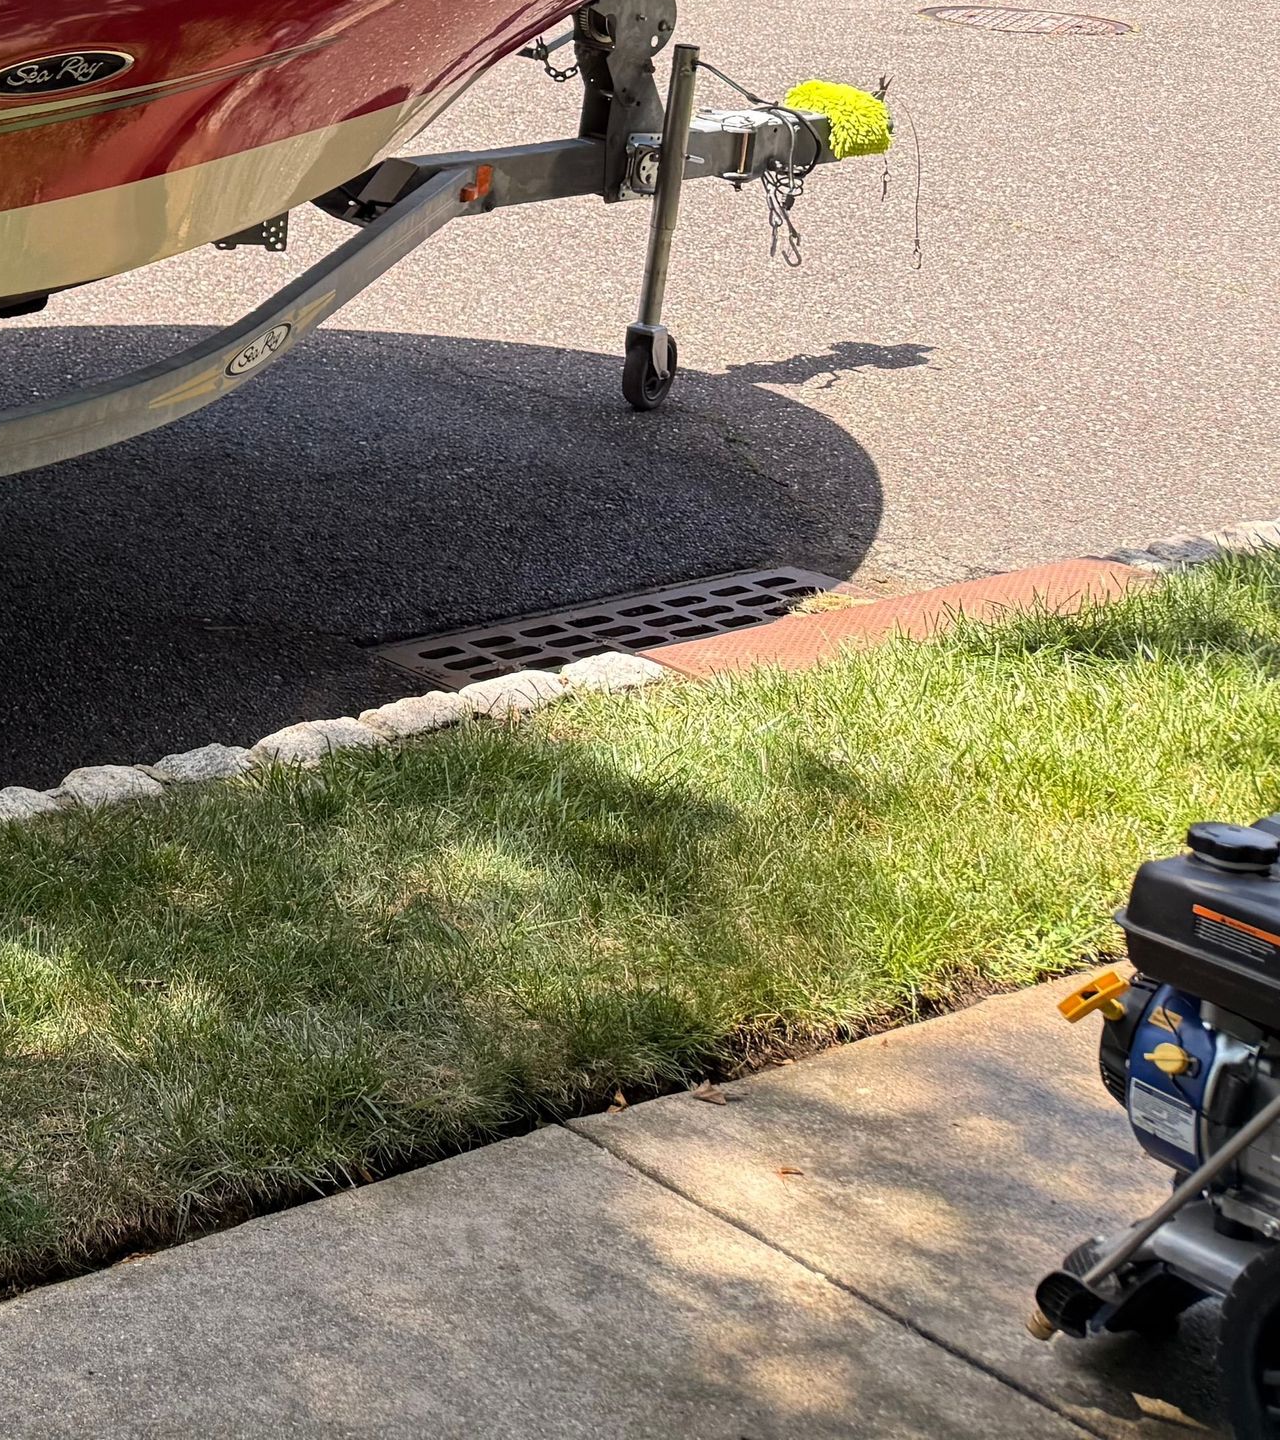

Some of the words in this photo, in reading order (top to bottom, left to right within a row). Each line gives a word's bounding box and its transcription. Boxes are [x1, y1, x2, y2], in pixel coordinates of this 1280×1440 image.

[6, 64, 54, 86] Sea
[55, 55, 104, 82] Ray
[238, 345, 259, 367] Sea
[261, 331, 282, 354] Ray
